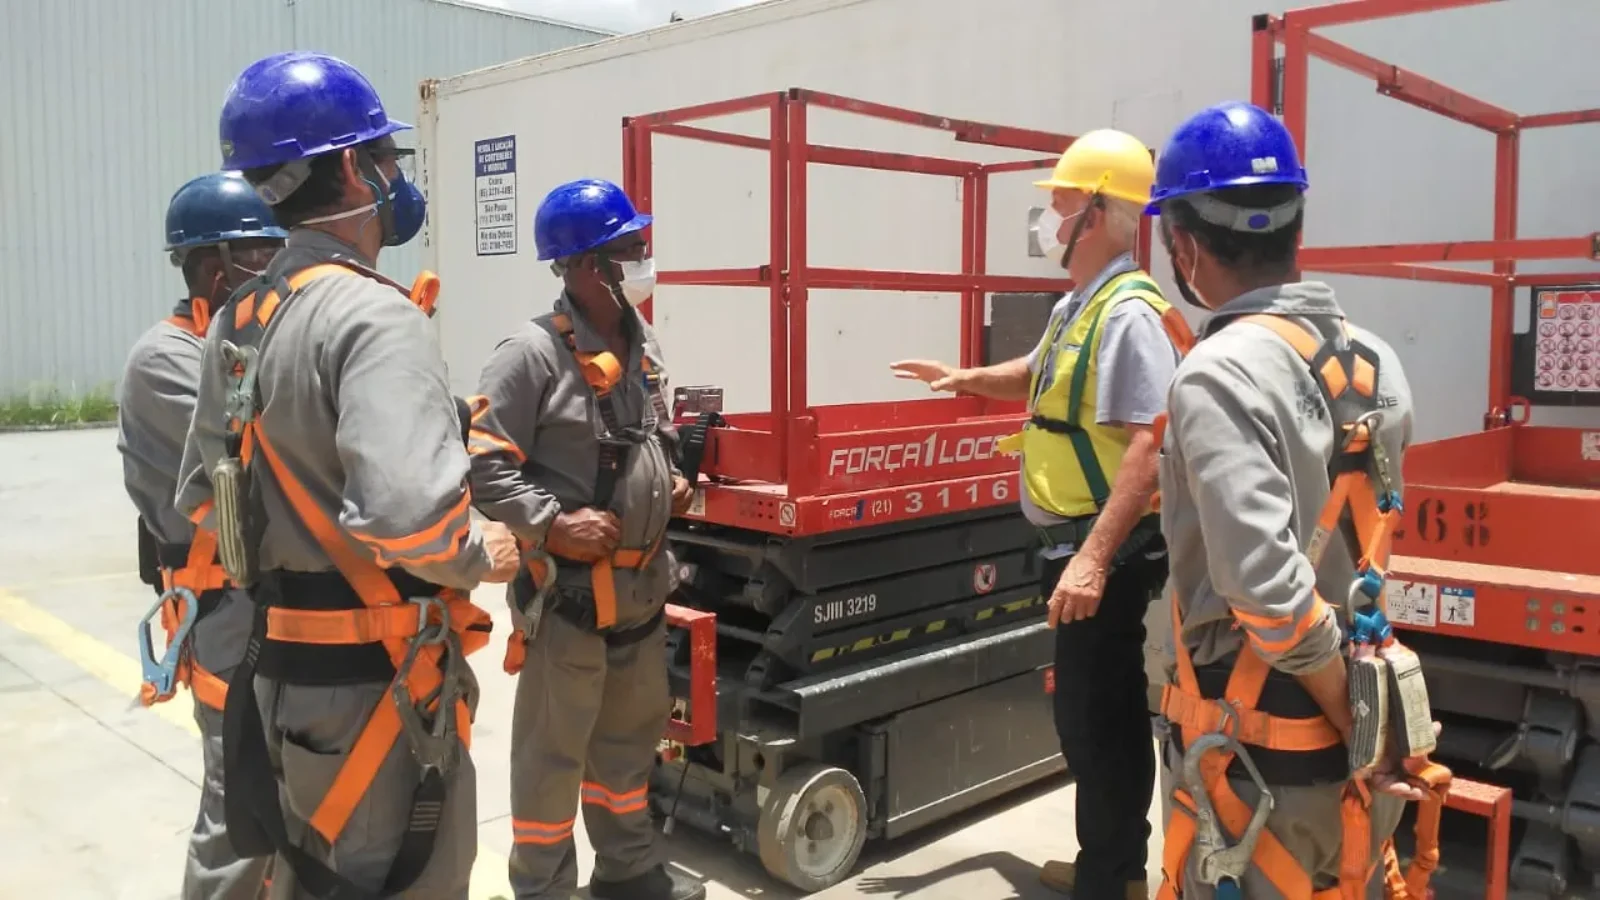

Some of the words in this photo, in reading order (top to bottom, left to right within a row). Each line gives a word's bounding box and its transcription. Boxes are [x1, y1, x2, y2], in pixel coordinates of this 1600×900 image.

[872, 499, 892, 517] (21)
[1391, 498, 1490, 548] 68
[847, 594, 876, 616] 3219
